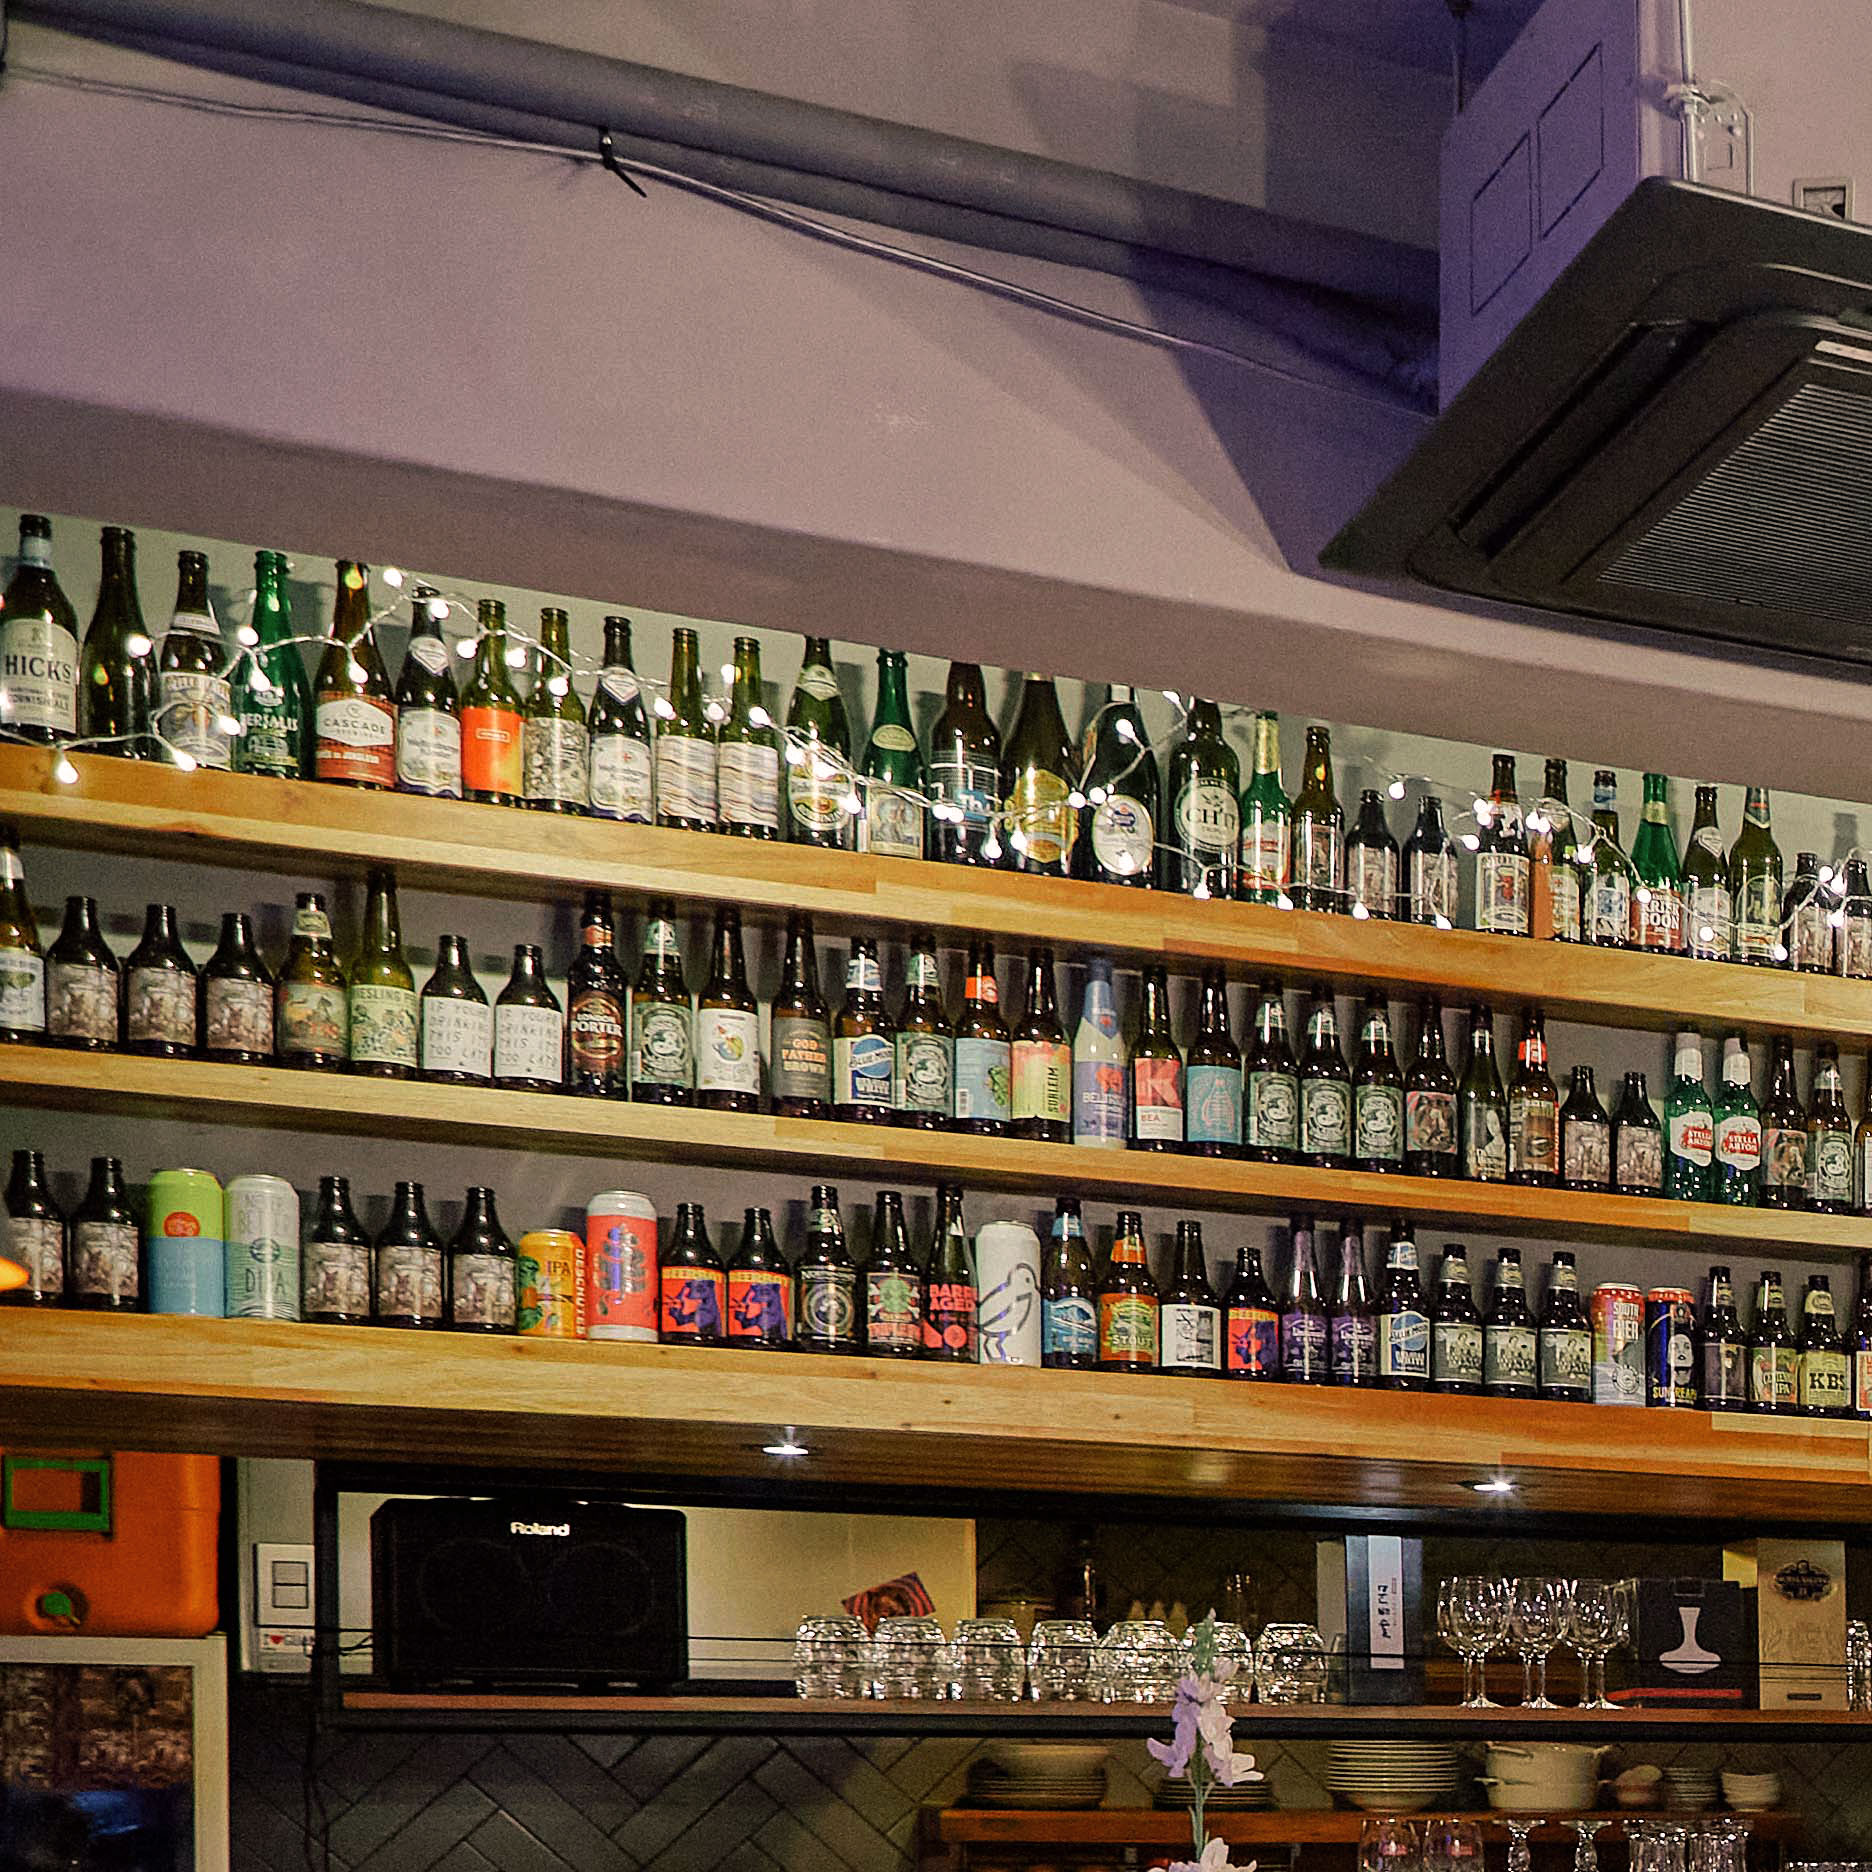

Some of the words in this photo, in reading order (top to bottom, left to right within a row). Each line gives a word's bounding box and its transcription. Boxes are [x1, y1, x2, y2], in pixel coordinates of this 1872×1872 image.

[5, 654, 72, 684] HICKS
[323, 715, 387, 737] CASCADE
[1644, 912, 1681, 931] BOON
[545, 1259, 575, 1276] IPA
[930, 1296, 976, 1312] AGED
[1111, 1334, 1154, 1349] STOUT
[511, 1521, 571, 1536] Roland
